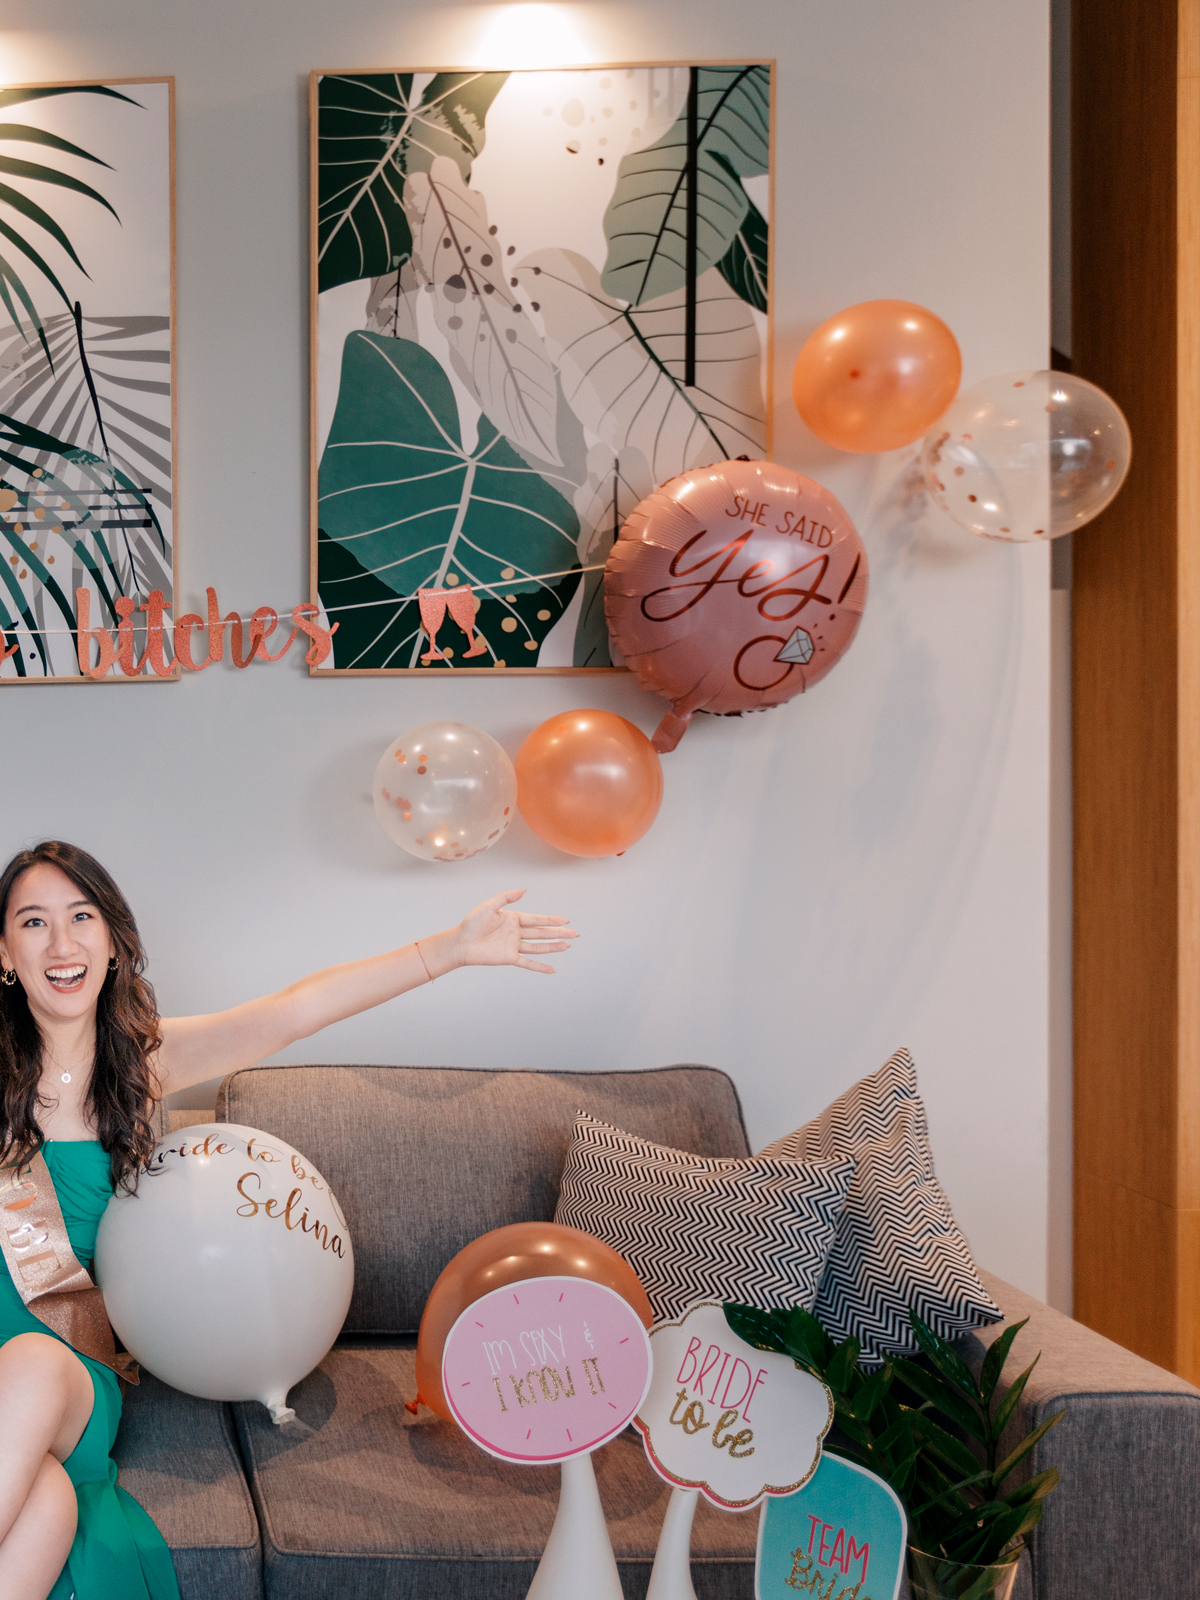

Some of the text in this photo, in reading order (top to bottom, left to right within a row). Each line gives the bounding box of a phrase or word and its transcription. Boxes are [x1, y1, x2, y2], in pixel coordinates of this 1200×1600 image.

[725, 495, 834, 549] SHE SAID
[75, 586, 340, 680] bitches
[152, 1132, 324, 1191] ride to be
[235, 1171, 346, 1259] Selina
[5, 1218, 63, 1284] BE
[519, 1324, 567, 1367] SEXY
[492, 1356, 606, 1413] I KNOW IT
[676, 1335, 769, 1424] BRIDE
[668, 1386, 757, 1459] to be
[784, 1546, 873, 1600] Brid
[807, 1513, 870, 1585] TEAM
